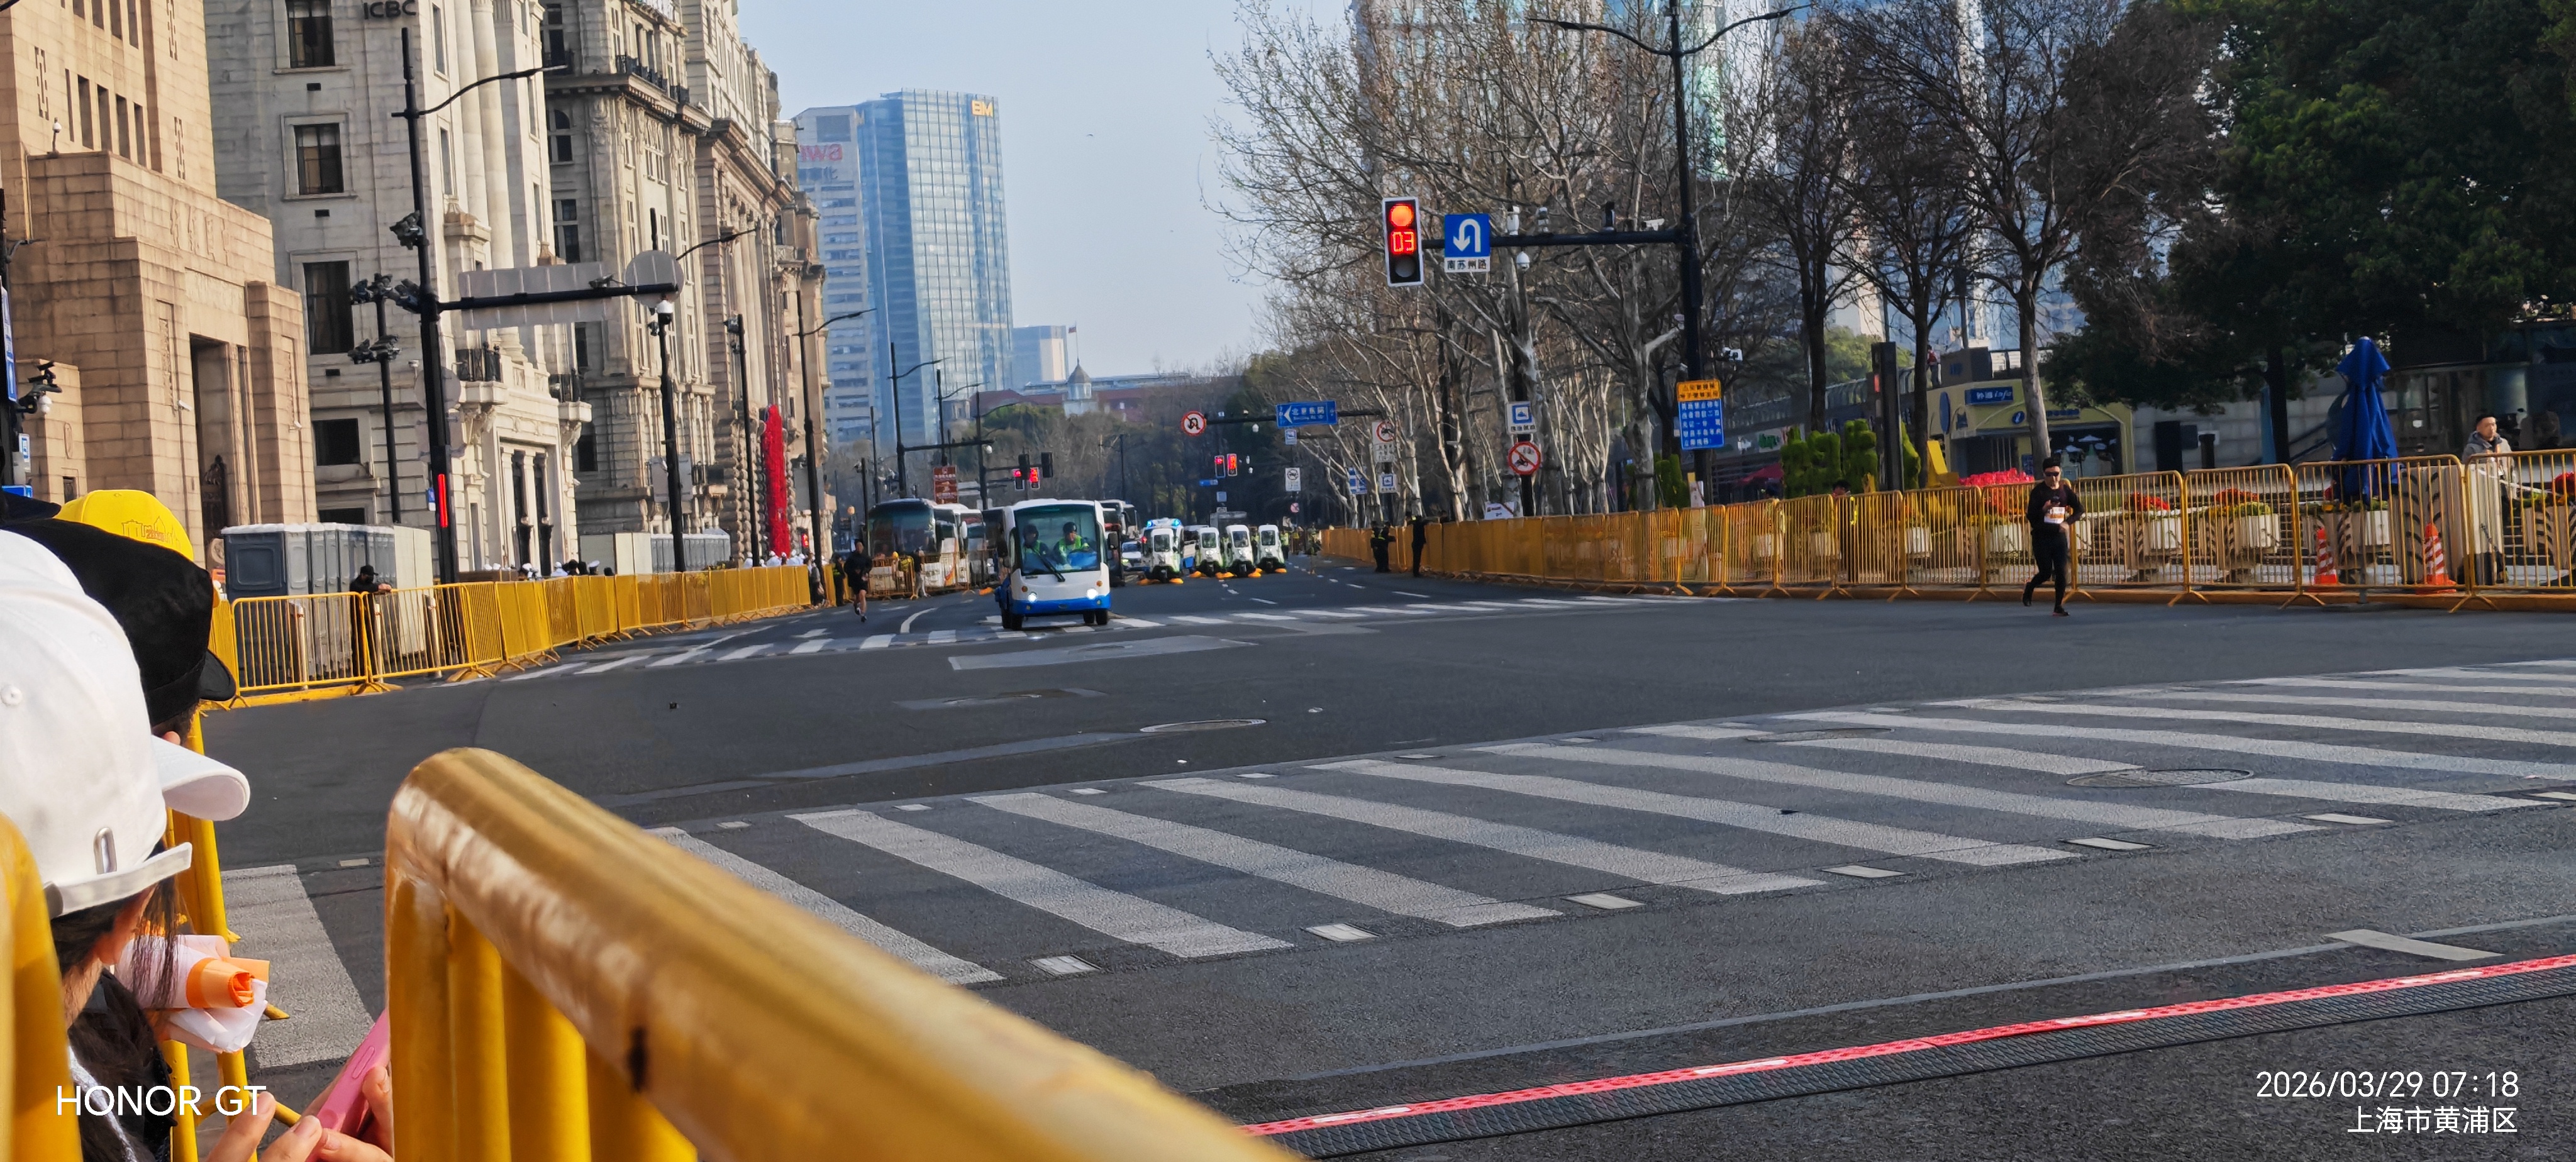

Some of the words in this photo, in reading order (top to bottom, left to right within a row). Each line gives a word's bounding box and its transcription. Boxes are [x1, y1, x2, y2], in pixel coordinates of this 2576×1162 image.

[364, 0, 417, 19] ICBC
[1392, 230, 1414, 252] 03
[1447, 259, 1487, 270] 南苏州路
